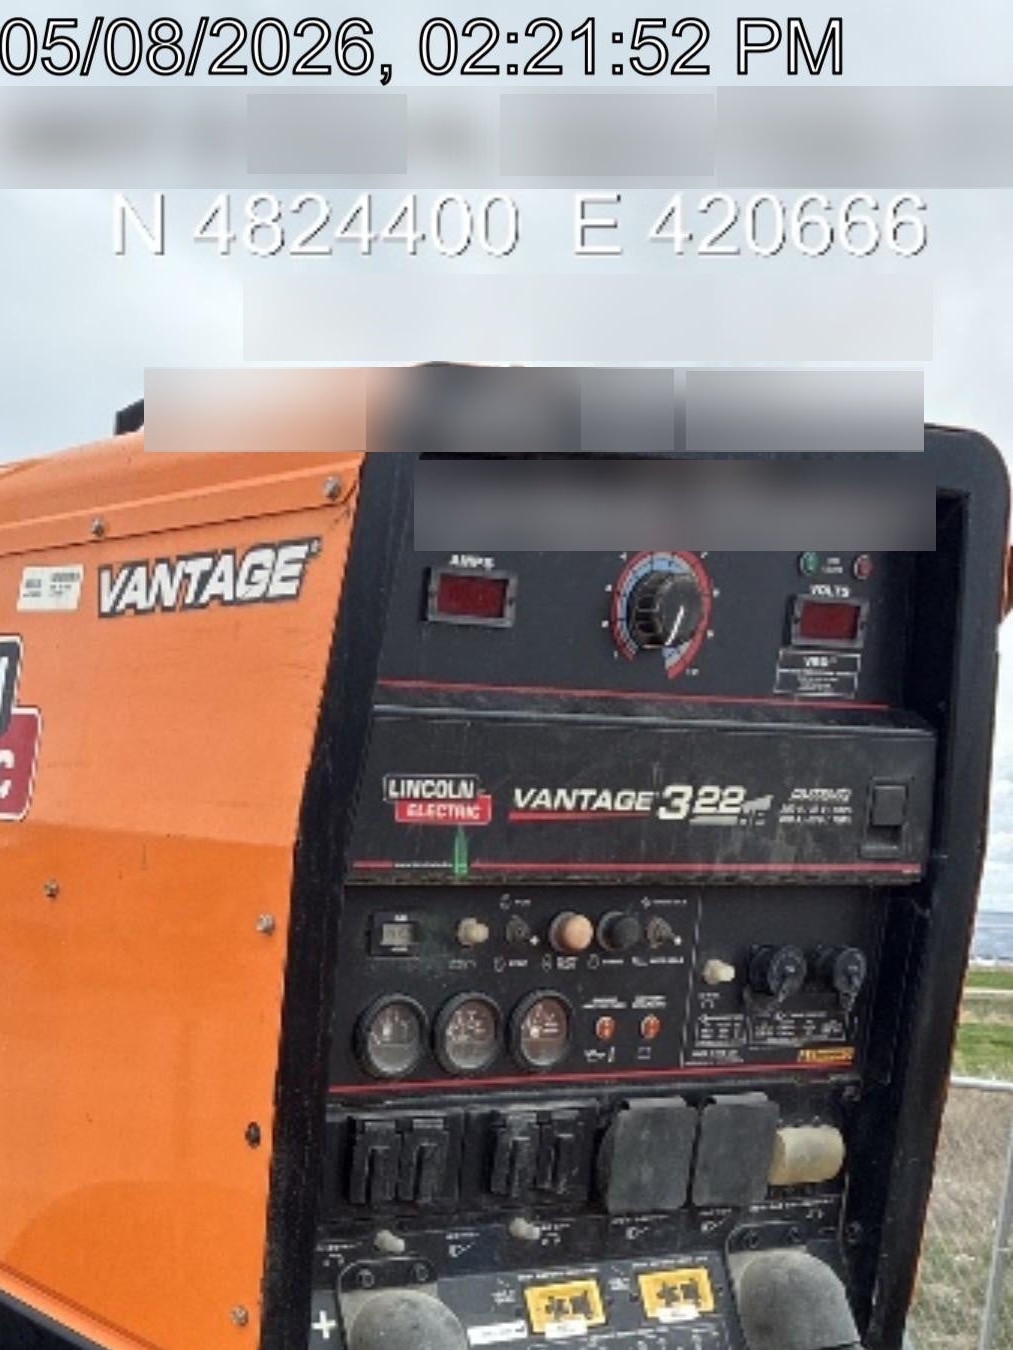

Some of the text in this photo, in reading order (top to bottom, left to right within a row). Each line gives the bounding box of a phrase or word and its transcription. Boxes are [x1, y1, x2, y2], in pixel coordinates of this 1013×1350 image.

[99, 544, 309, 614] VANTAGE
[388, 779, 475, 799] LINCOLN
[513, 787, 655, 812] VANTAGE
[658, 784, 747, 821] 322
[406, 803, 482, 820] ELECTRIC
